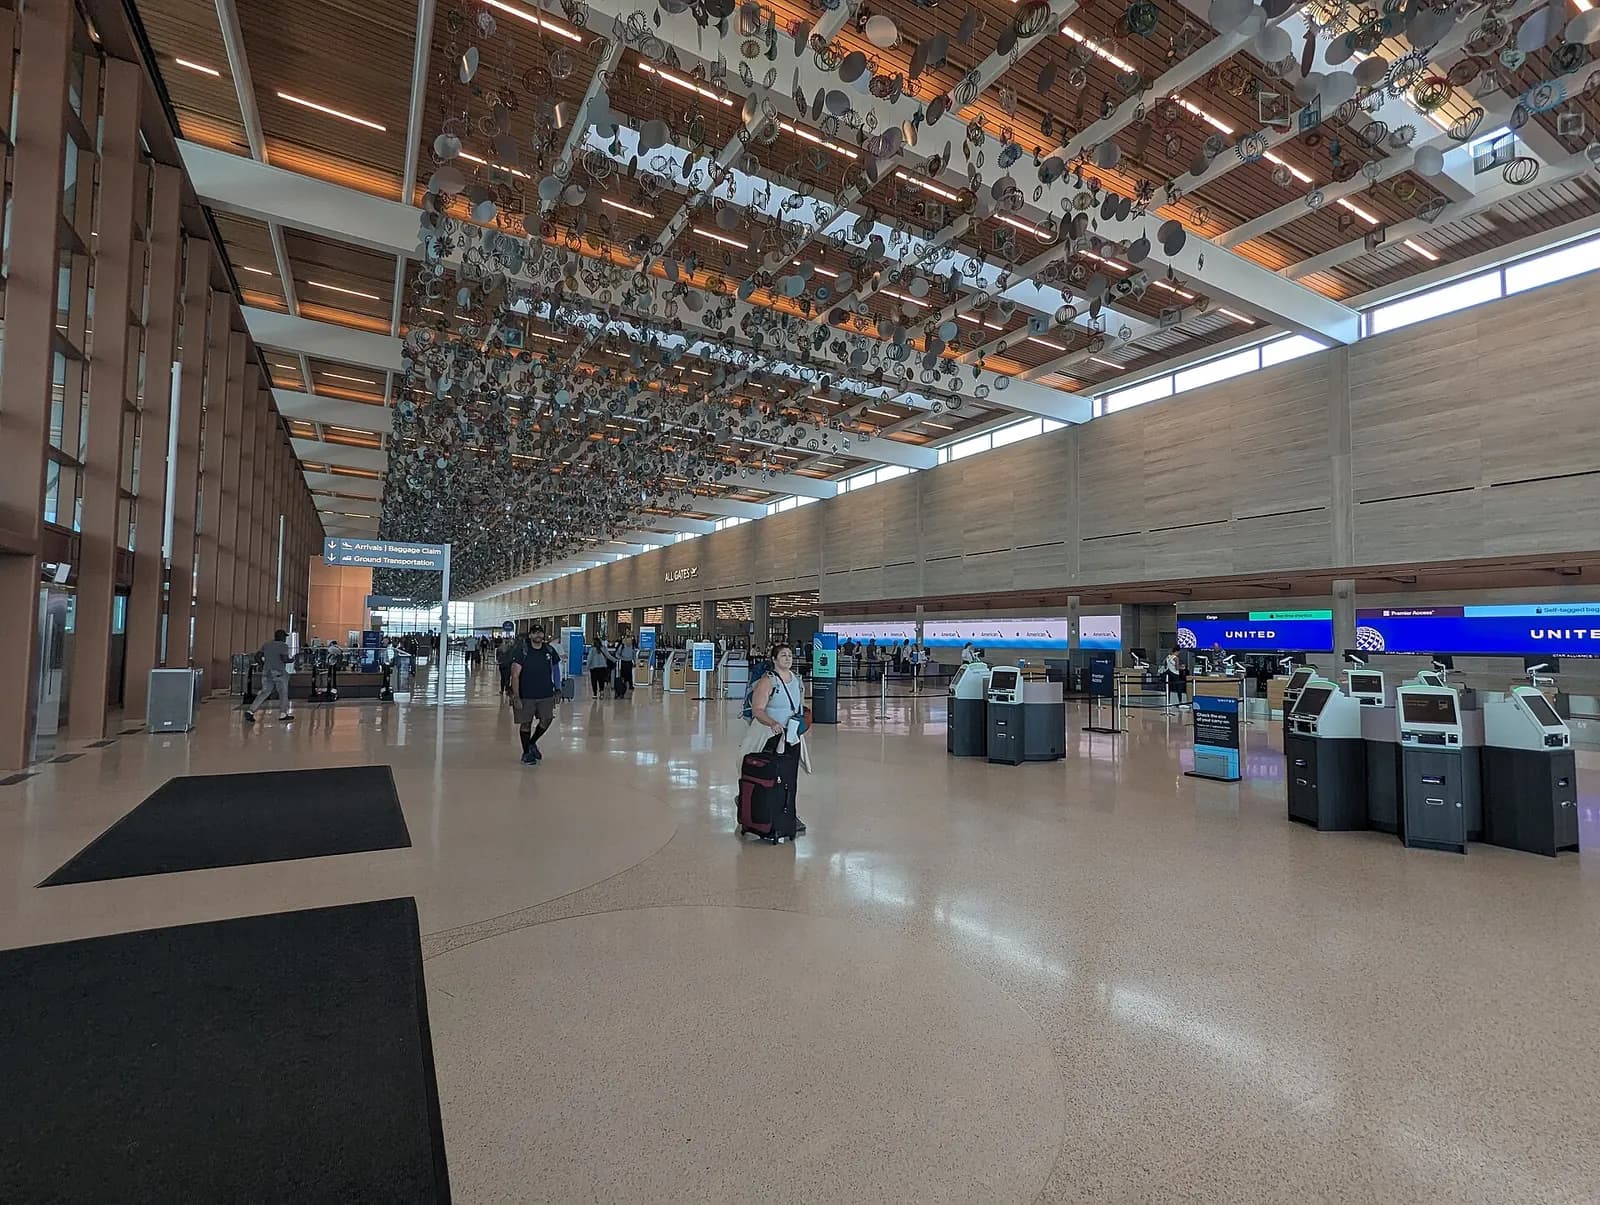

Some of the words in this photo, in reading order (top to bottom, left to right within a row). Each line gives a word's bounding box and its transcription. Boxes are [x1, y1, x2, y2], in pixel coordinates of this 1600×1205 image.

[354, 543, 383, 552] Arrivals
[388, 545, 420, 554] Baggage
[421, 547, 442, 555] Claim
[353, 555, 382, 563] Ground
[383, 557, 435, 566] Transportation
[665, 571, 674, 583] ALL
[674, 568, 690, 580] GATES
[1225, 630, 1276, 639] UNITED
[1530, 629, 1600, 639] UNITE
